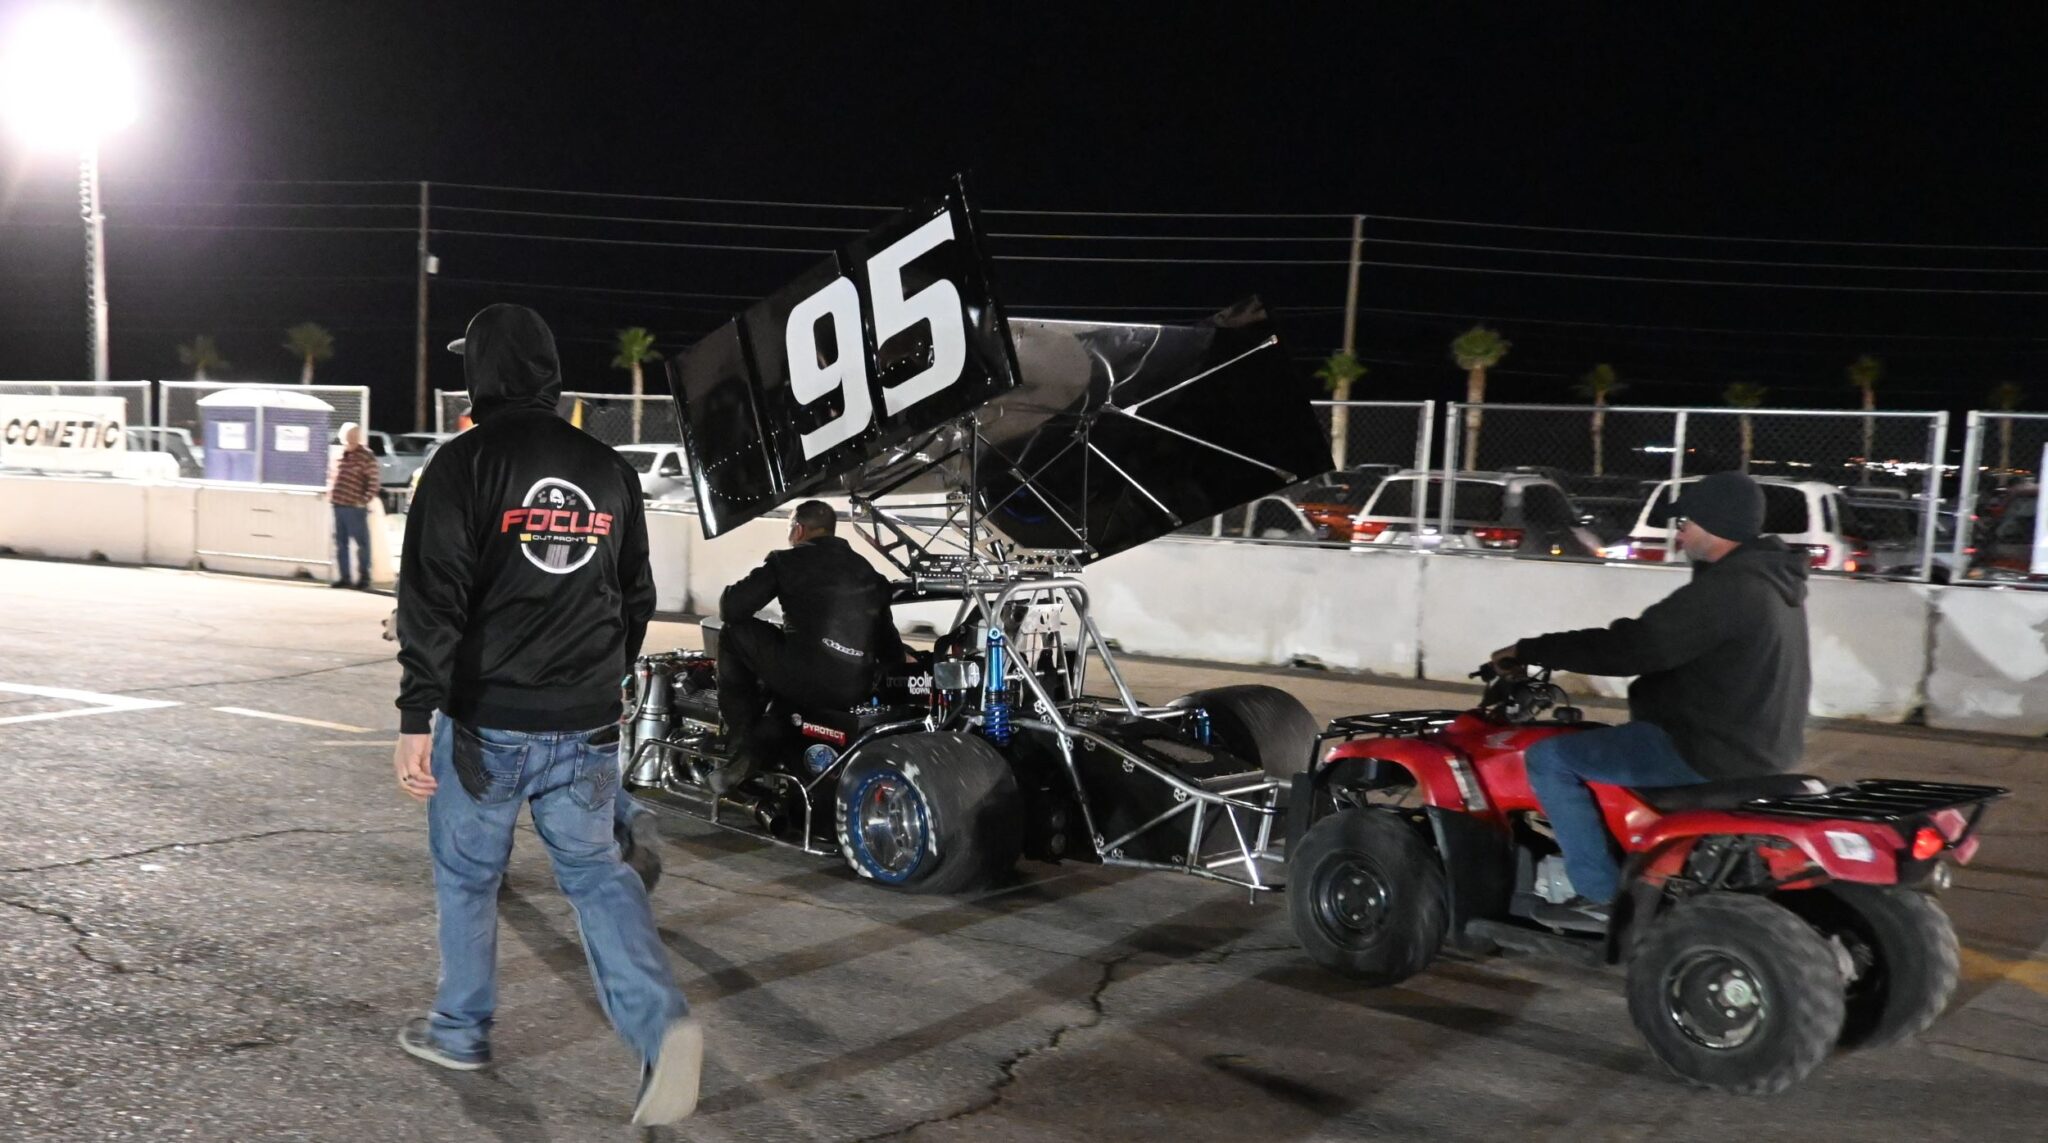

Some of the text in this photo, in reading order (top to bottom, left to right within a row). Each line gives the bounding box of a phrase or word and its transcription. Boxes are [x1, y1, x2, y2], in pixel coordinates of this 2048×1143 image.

[786, 210, 967, 461] 95
[5, 417, 120, 449] COMETIC
[500, 508, 613, 535] FOCUS
[803, 722, 845, 740] PYROTECT
